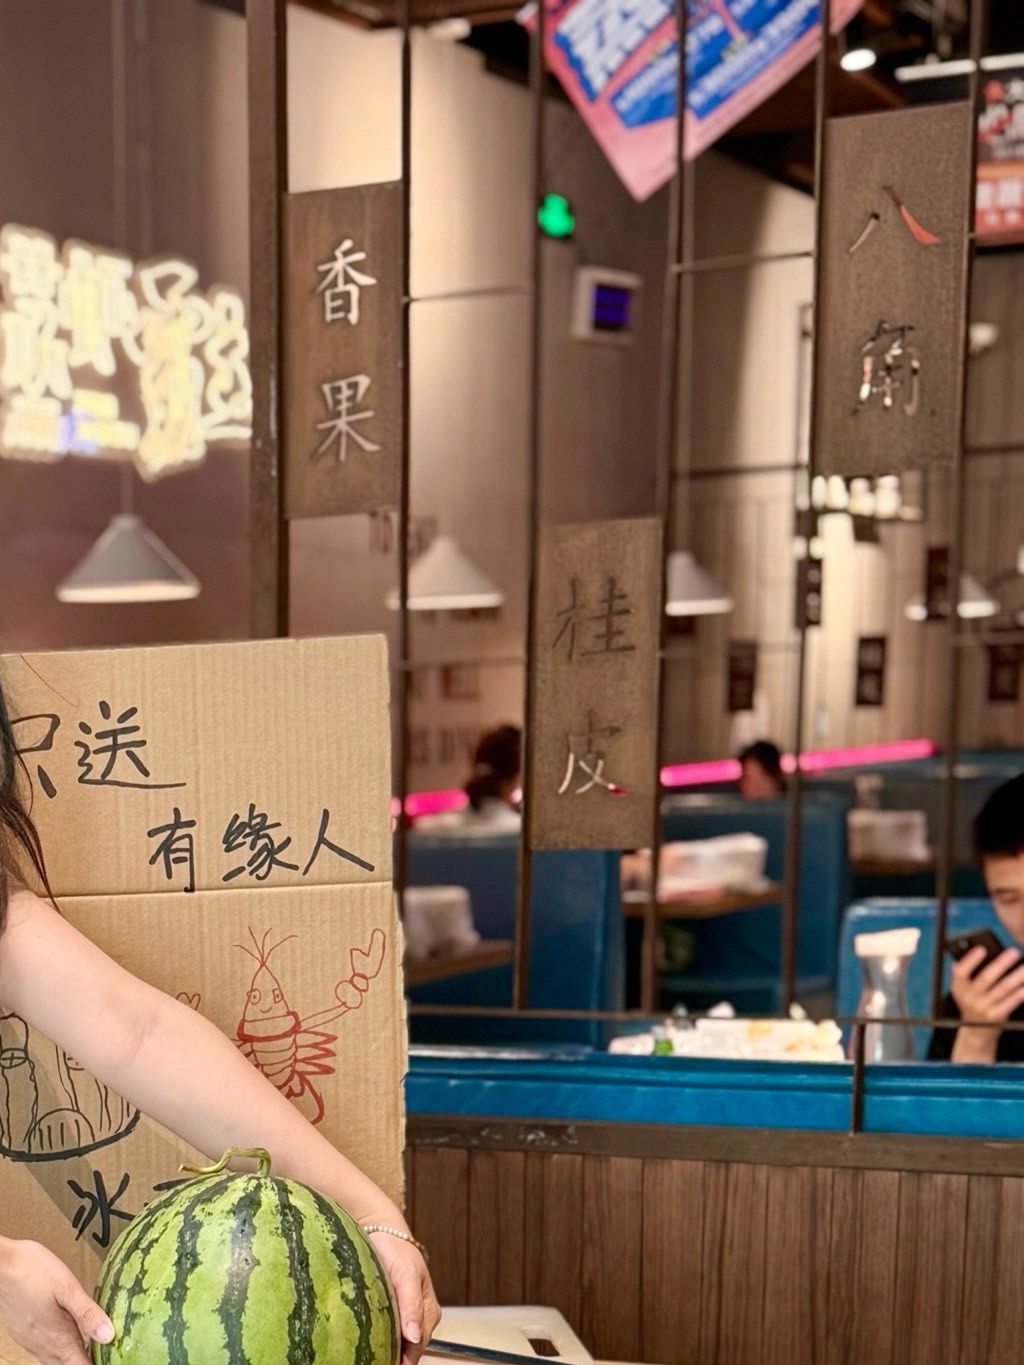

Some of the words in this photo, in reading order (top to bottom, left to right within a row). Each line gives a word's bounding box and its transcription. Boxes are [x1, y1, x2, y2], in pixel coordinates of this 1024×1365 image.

[311, 238, 379, 463] 香果
[551, 576, 636, 795] 桂皮
[147, 803, 375, 893] 有缘人
